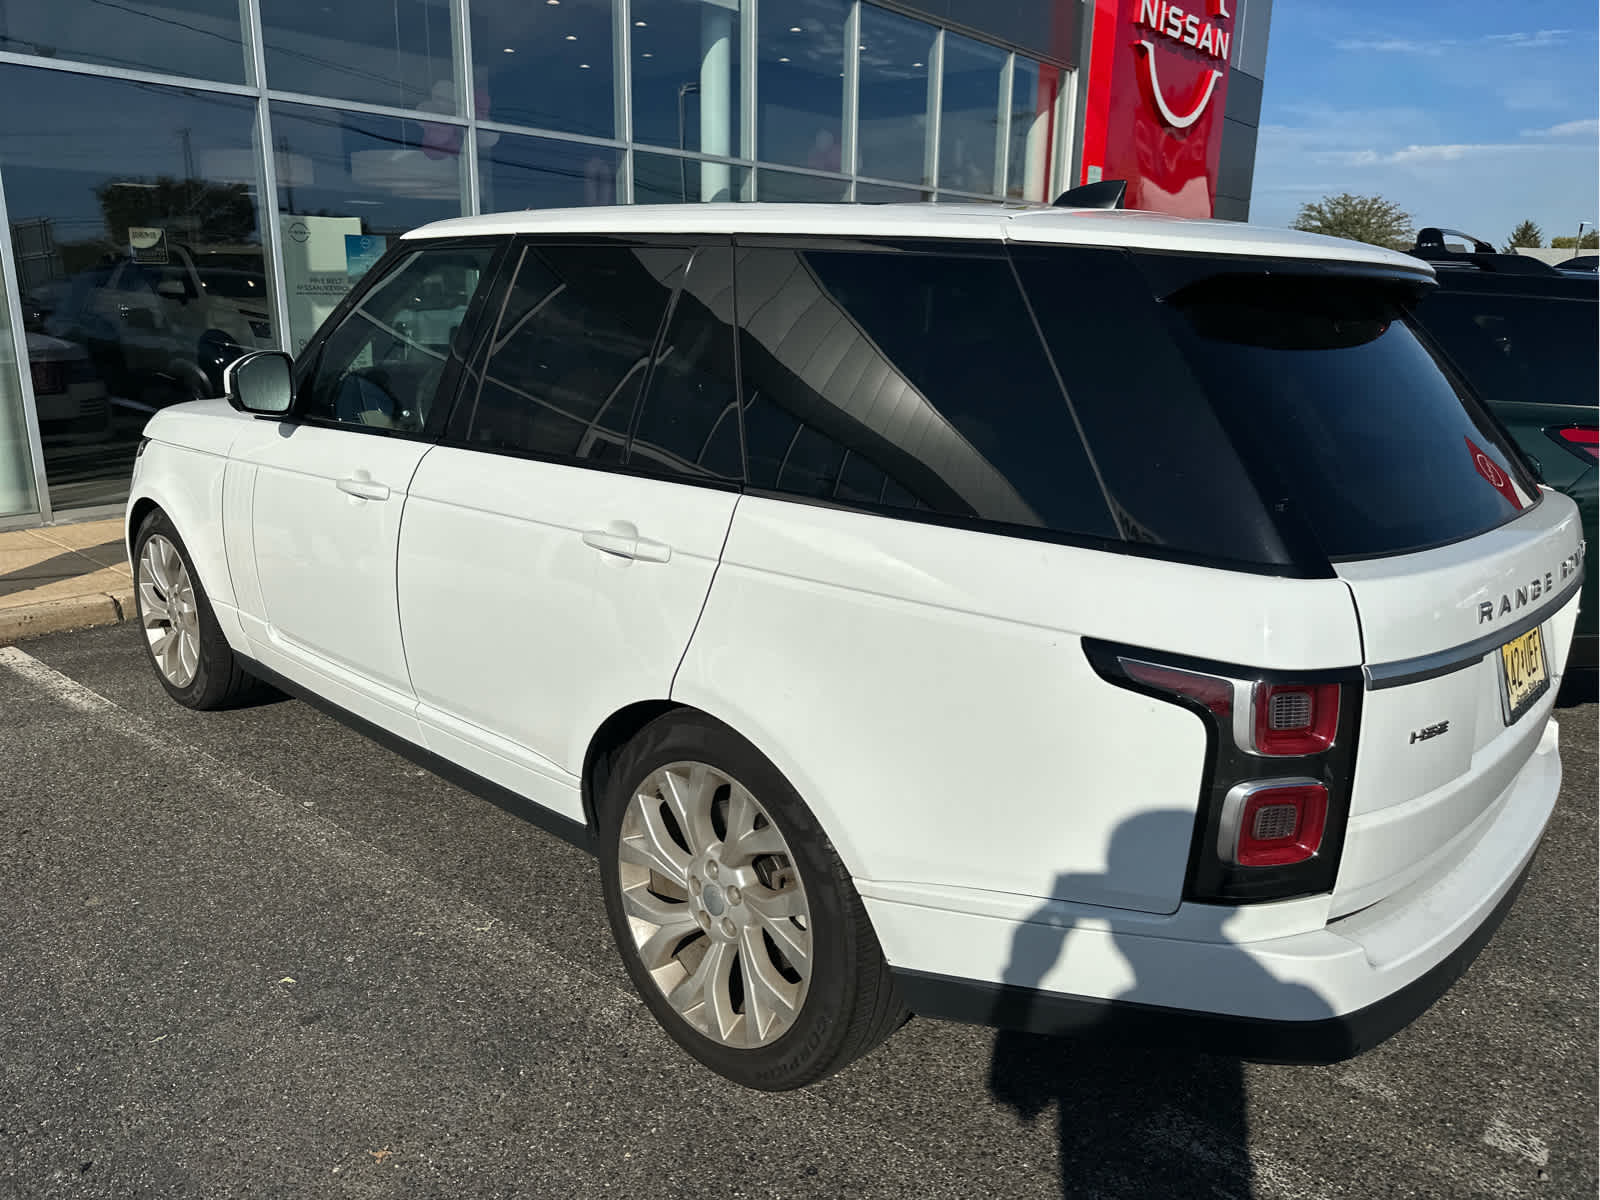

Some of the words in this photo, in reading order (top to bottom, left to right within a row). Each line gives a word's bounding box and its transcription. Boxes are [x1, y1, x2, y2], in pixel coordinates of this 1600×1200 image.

[1139, 0, 1230, 60] NISSAN
[1477, 571, 1552, 624] RANGE
[1409, 719, 1450, 745] HSE
